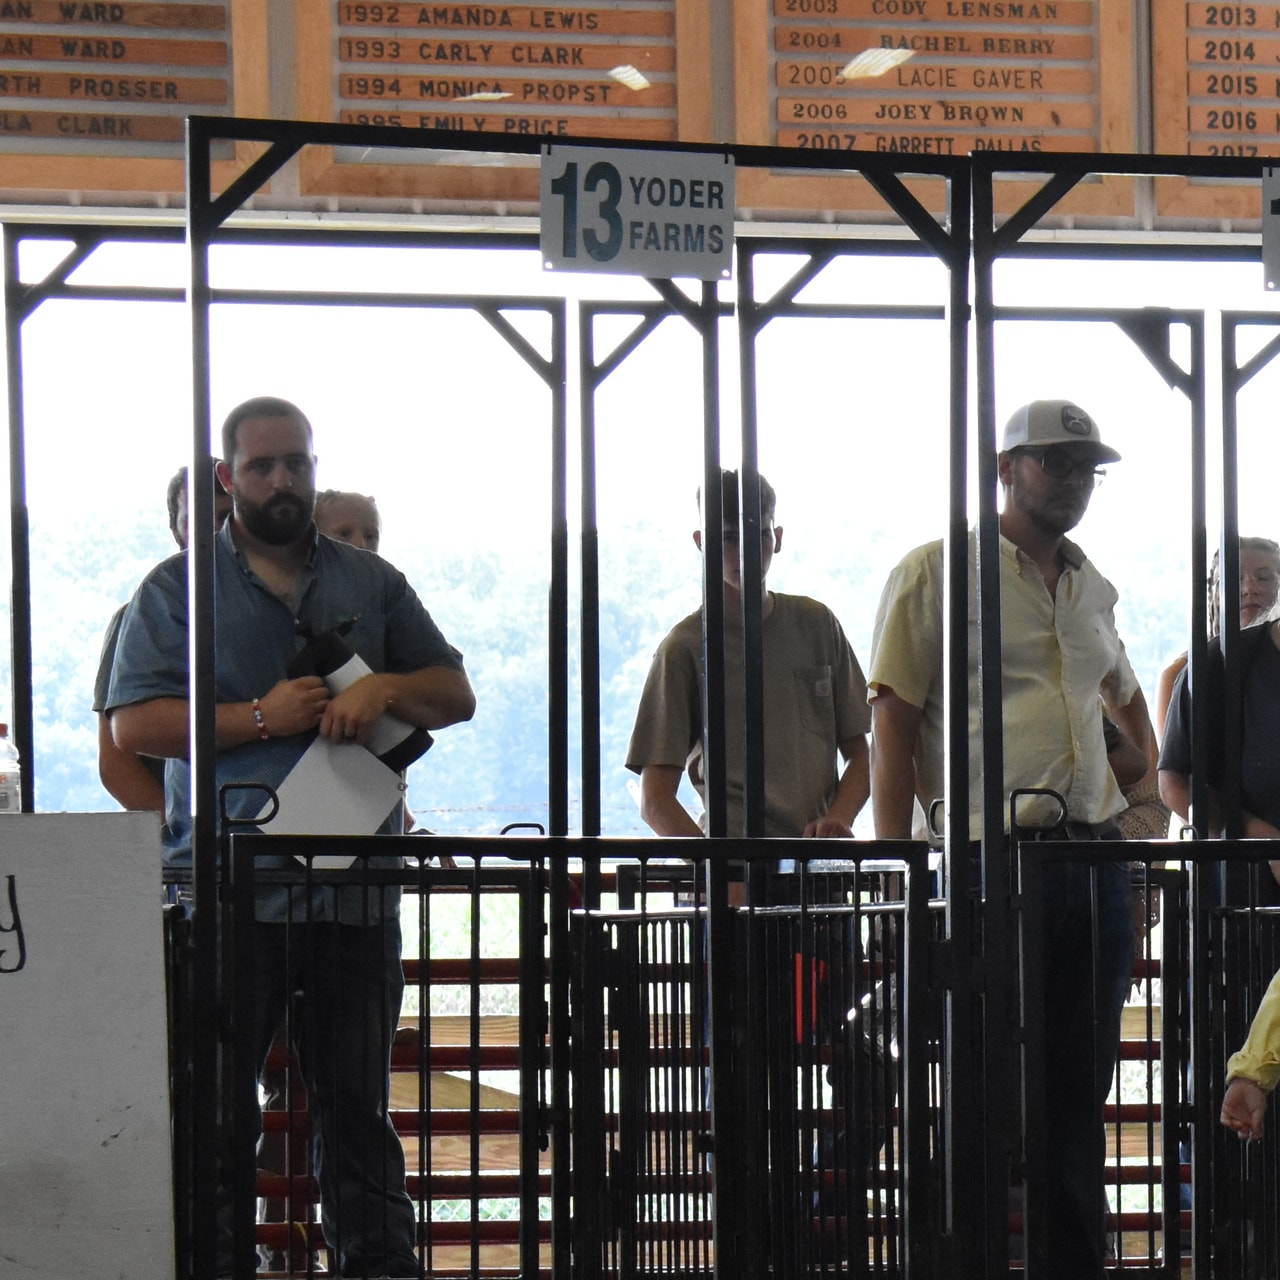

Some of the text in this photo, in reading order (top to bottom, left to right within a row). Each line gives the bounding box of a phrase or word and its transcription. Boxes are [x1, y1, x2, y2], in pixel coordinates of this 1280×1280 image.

[59, 3, 125, 22] WARD
[347, 5, 599, 30] 1992 AMANDA LEWIS
[786, 0, 1058, 18] 2003 CODY LENSMAN
[1206, 7, 1256, 26] 2013
[60, 40, 126, 59] WARD
[346, 40, 585, 65] 1993 CARLY CLARK
[790, 32, 1055, 54] 2004 RACHEL BERRY
[1205, 41, 1255, 60] 2014
[790, 65, 1043, 89] 2005 LACIE GAVER
[1207, 75, 1258, 95] 2015
[69, 78, 178, 99] PROSSER
[347, 77, 611, 102] 1994 MONICA PROPST
[793, 103, 1024, 122] 2006 JOEY BROWN
[1207, 111, 1256, 130] 2016
[0, 115, 132, 136] LA CLARK
[419, 115, 486, 131] EMILY
[505, 118, 568, 135] PRICE
[797, 134, 1041, 154] 2007 GARRETT DALLAS
[629, 177, 724, 209] YODER
[551, 162, 623, 262] 13
[629, 221, 724, 254] FARMS
